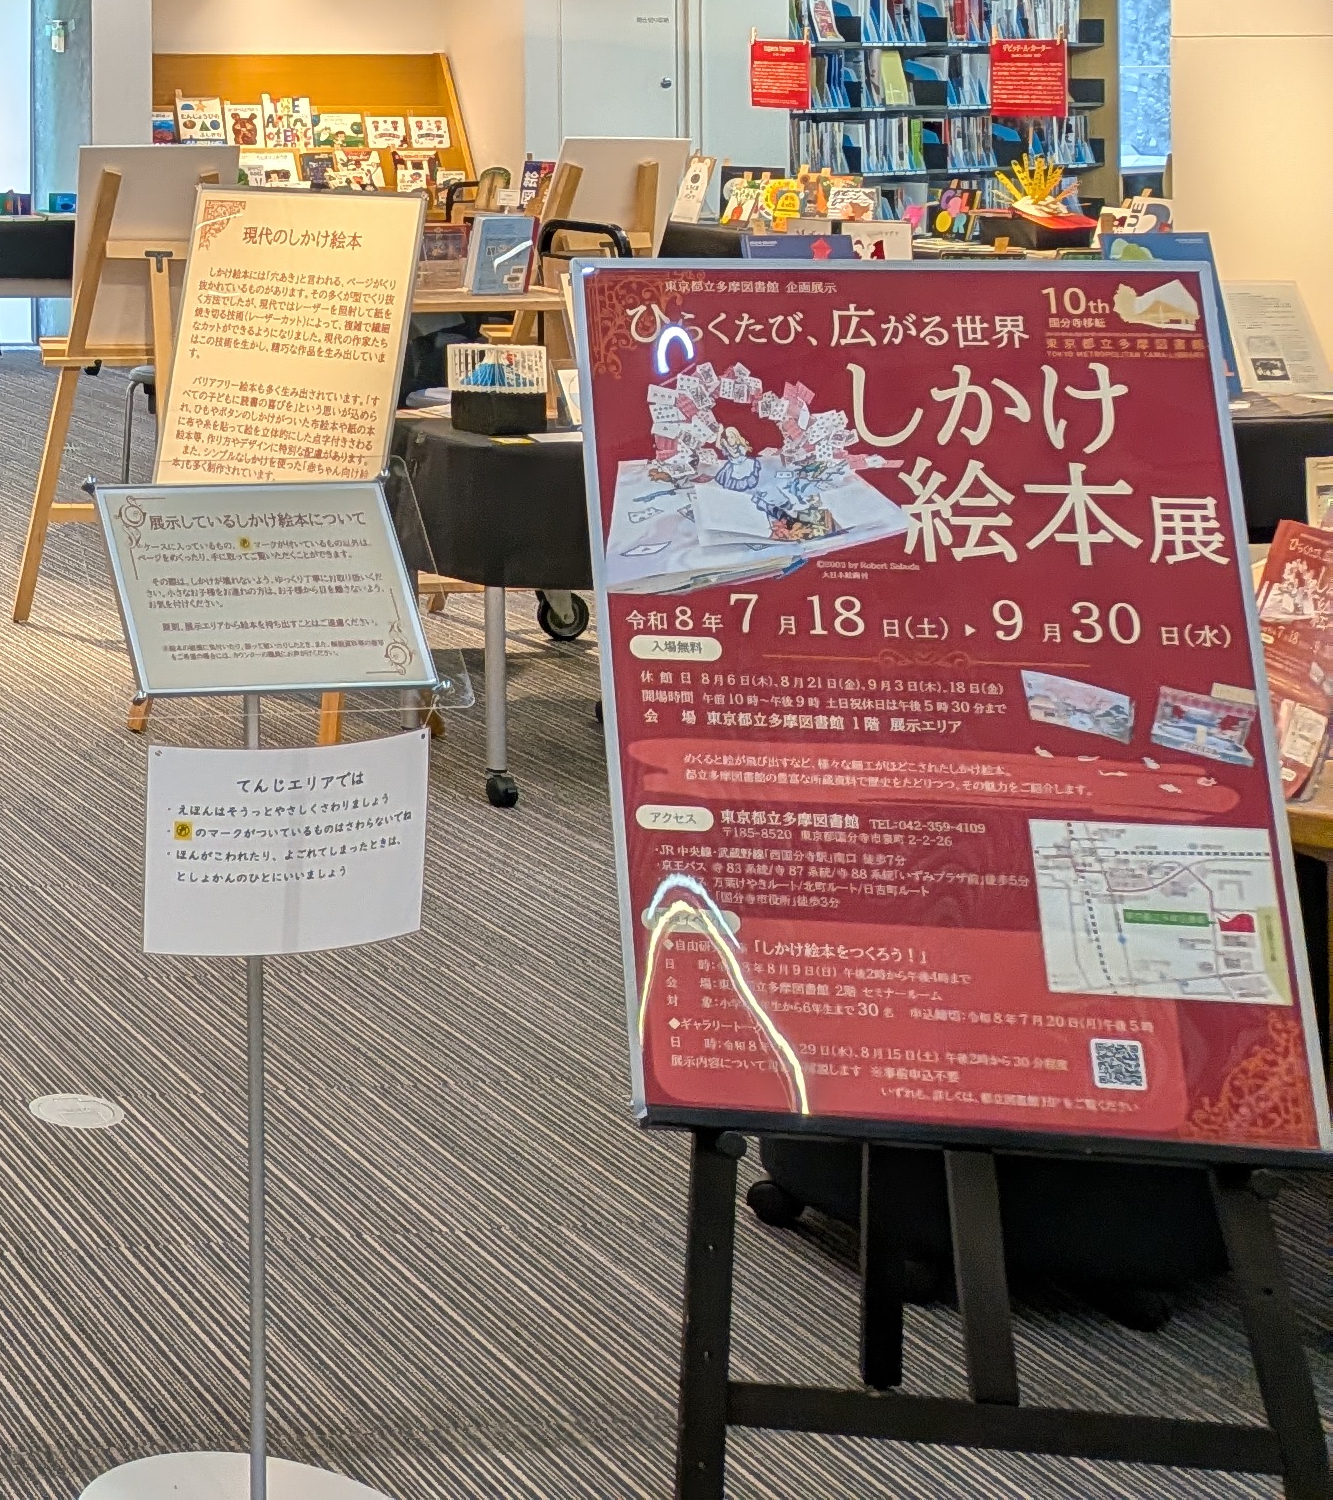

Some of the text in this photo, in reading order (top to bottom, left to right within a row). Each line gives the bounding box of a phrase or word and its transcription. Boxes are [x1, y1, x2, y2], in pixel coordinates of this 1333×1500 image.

[243, 225, 363, 250] 現代のしかけ絵本
[665, 280, 837, 295] 東京都立多摩図書館 企画展示
[1041, 287, 1110, 315] 10th
[626, 301, 1030, 350] ひらくたび、広がる世界
[845, 362, 1130, 453] しかけ
[148, 512, 367, 531] 展示しているしかけ絵本について
[897, 460, 1232, 569] 絵本展
[651, 640, 703, 654] 入場無料
[707, 711, 845, 731] 東京都立多摩図書館
[890, 718, 963, 734] 展示エリア
[236, 771, 365, 794] てんじエリアでは
[178, 792, 390, 817] えほんはそうっとやさしくさわりましょう
[195, 810, 412, 838] のマークがついているものはさわらないでね
[649, 812, 698, 825] アクセス
[720, 809, 860, 830] 東京都立多摩図書館
[177, 865, 347, 883] としょかんのひとにいいましょう
